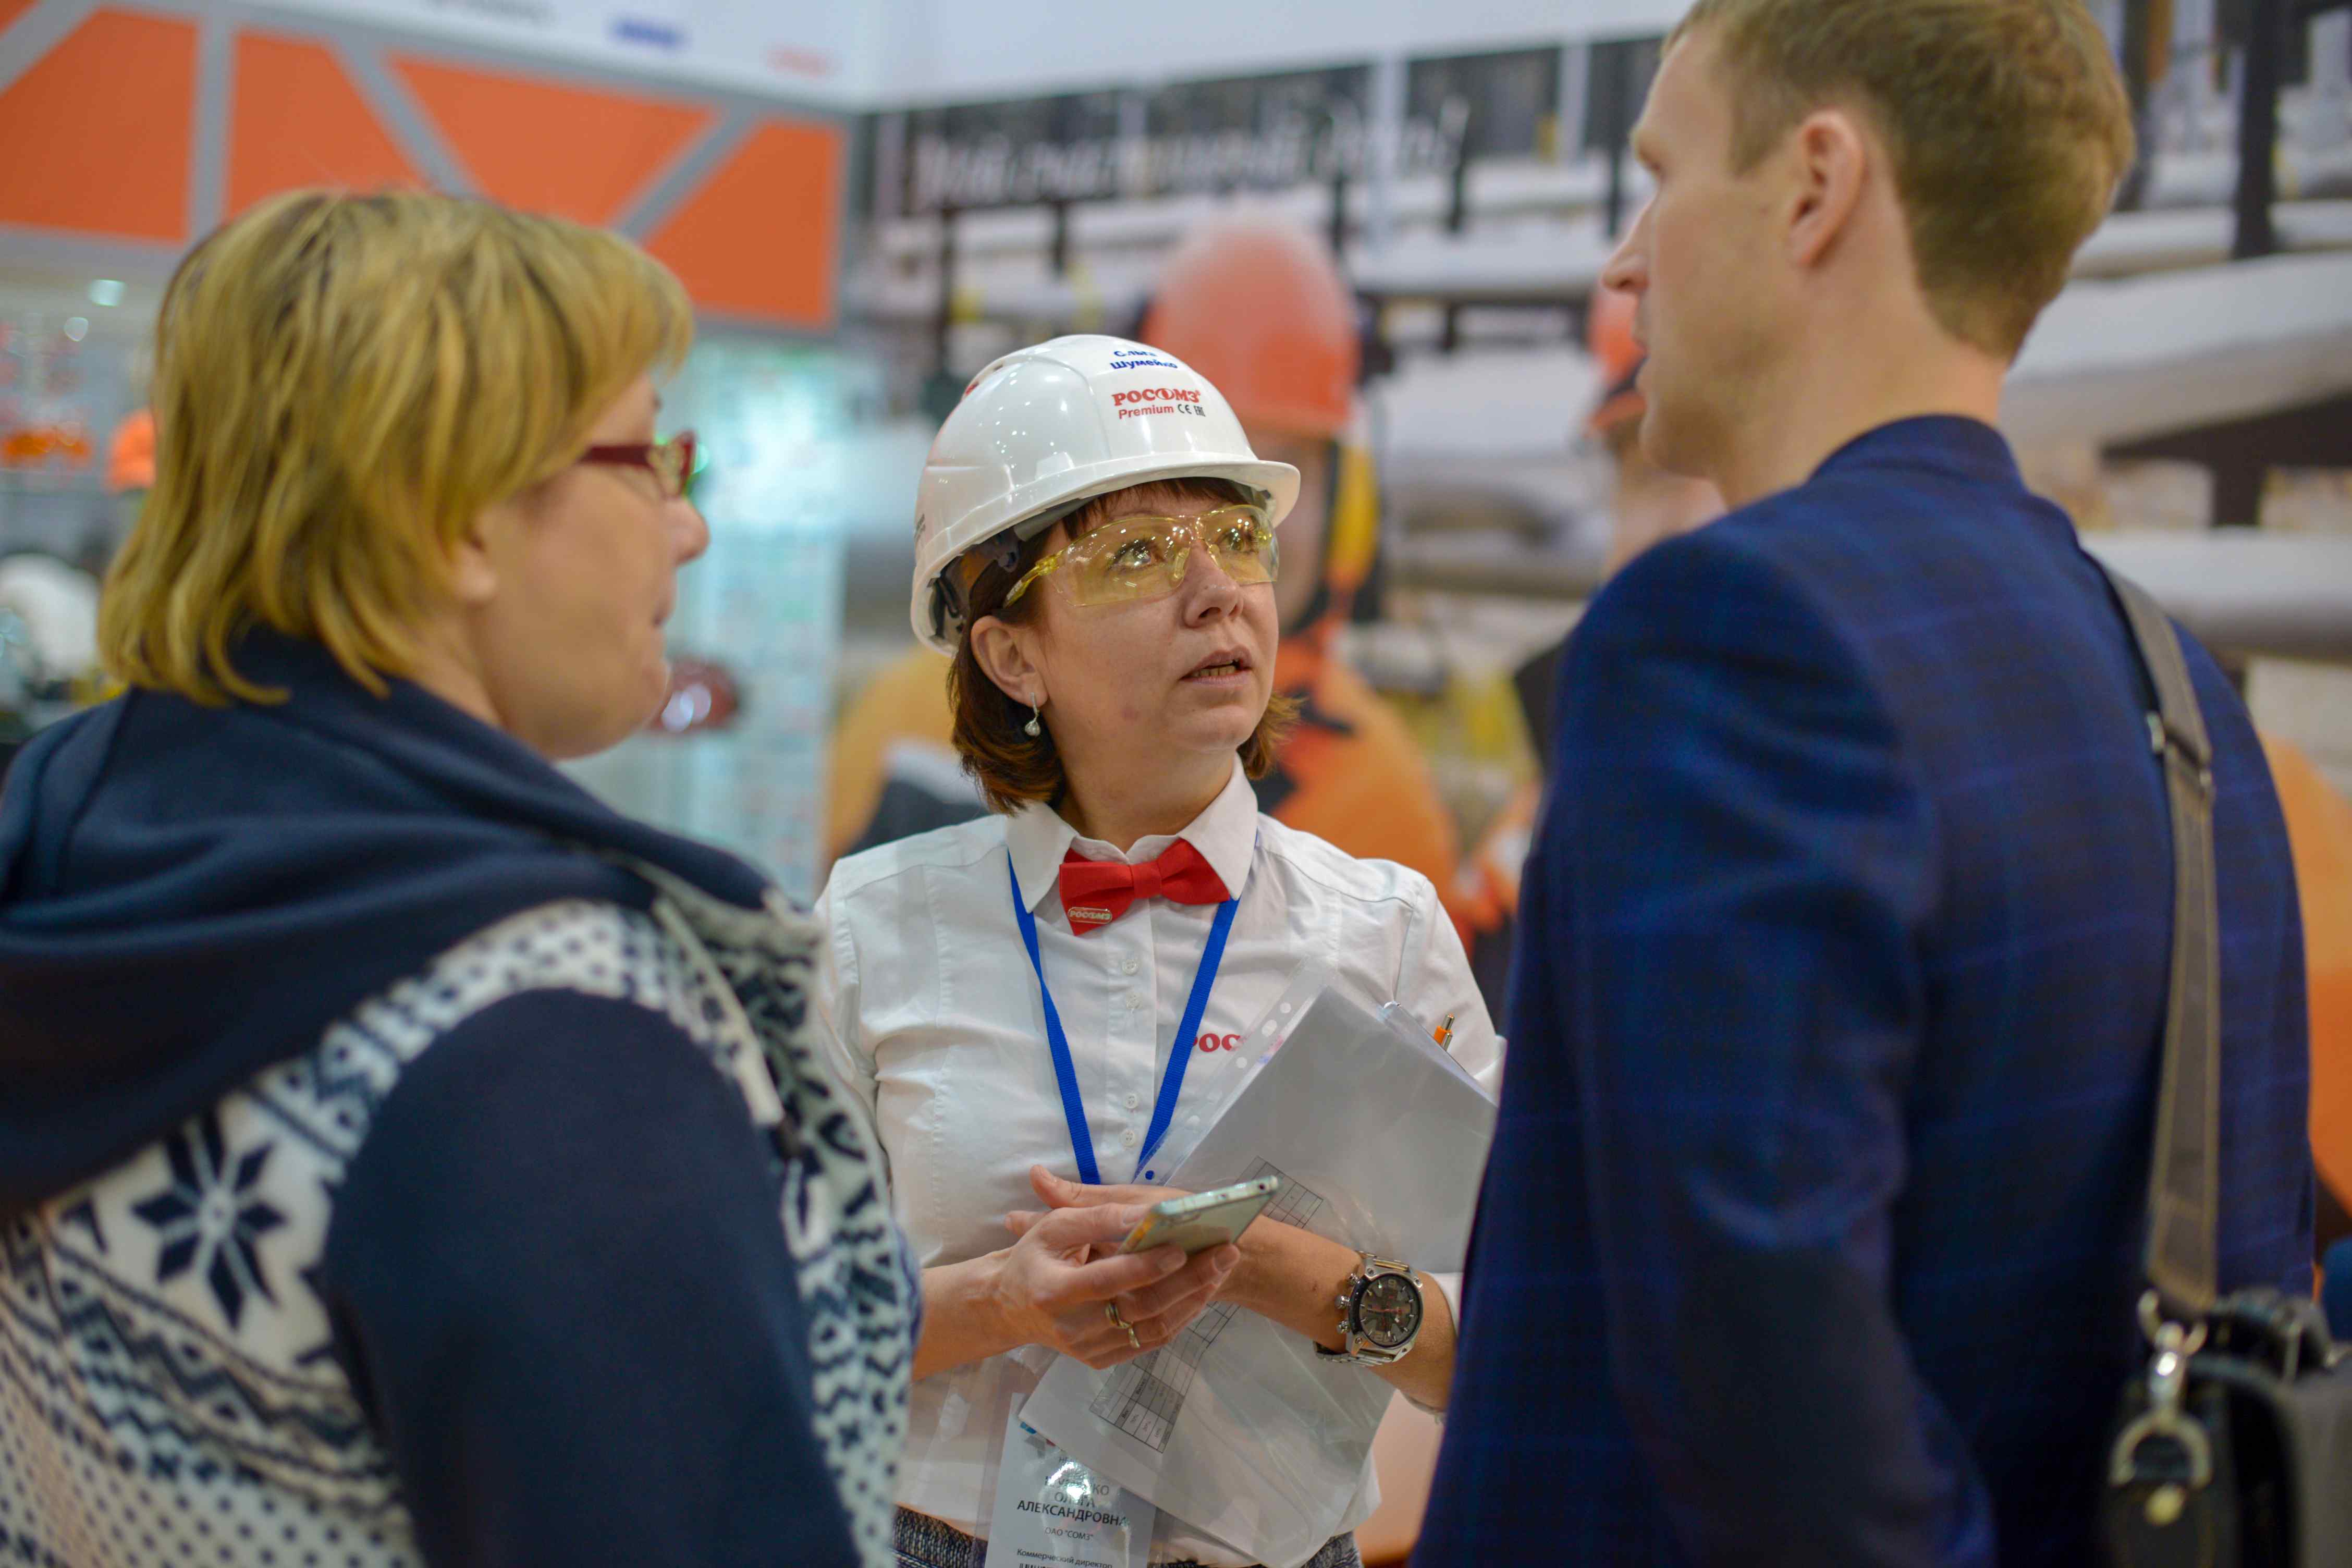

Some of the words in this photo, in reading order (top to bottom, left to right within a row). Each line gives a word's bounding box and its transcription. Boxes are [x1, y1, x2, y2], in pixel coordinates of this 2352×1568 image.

[1118, 405, 1174, 419] Premium
[1193, 1033, 1243, 1052] ОС
[1016, 1500, 1130, 1527] АЛЕКСАНДРОВНА
[1044, 1527, 1063, 1536] ОАО
[1016, 1548, 1074, 1563] Коммерческий
[1075, 1559, 1113, 1568] директор
